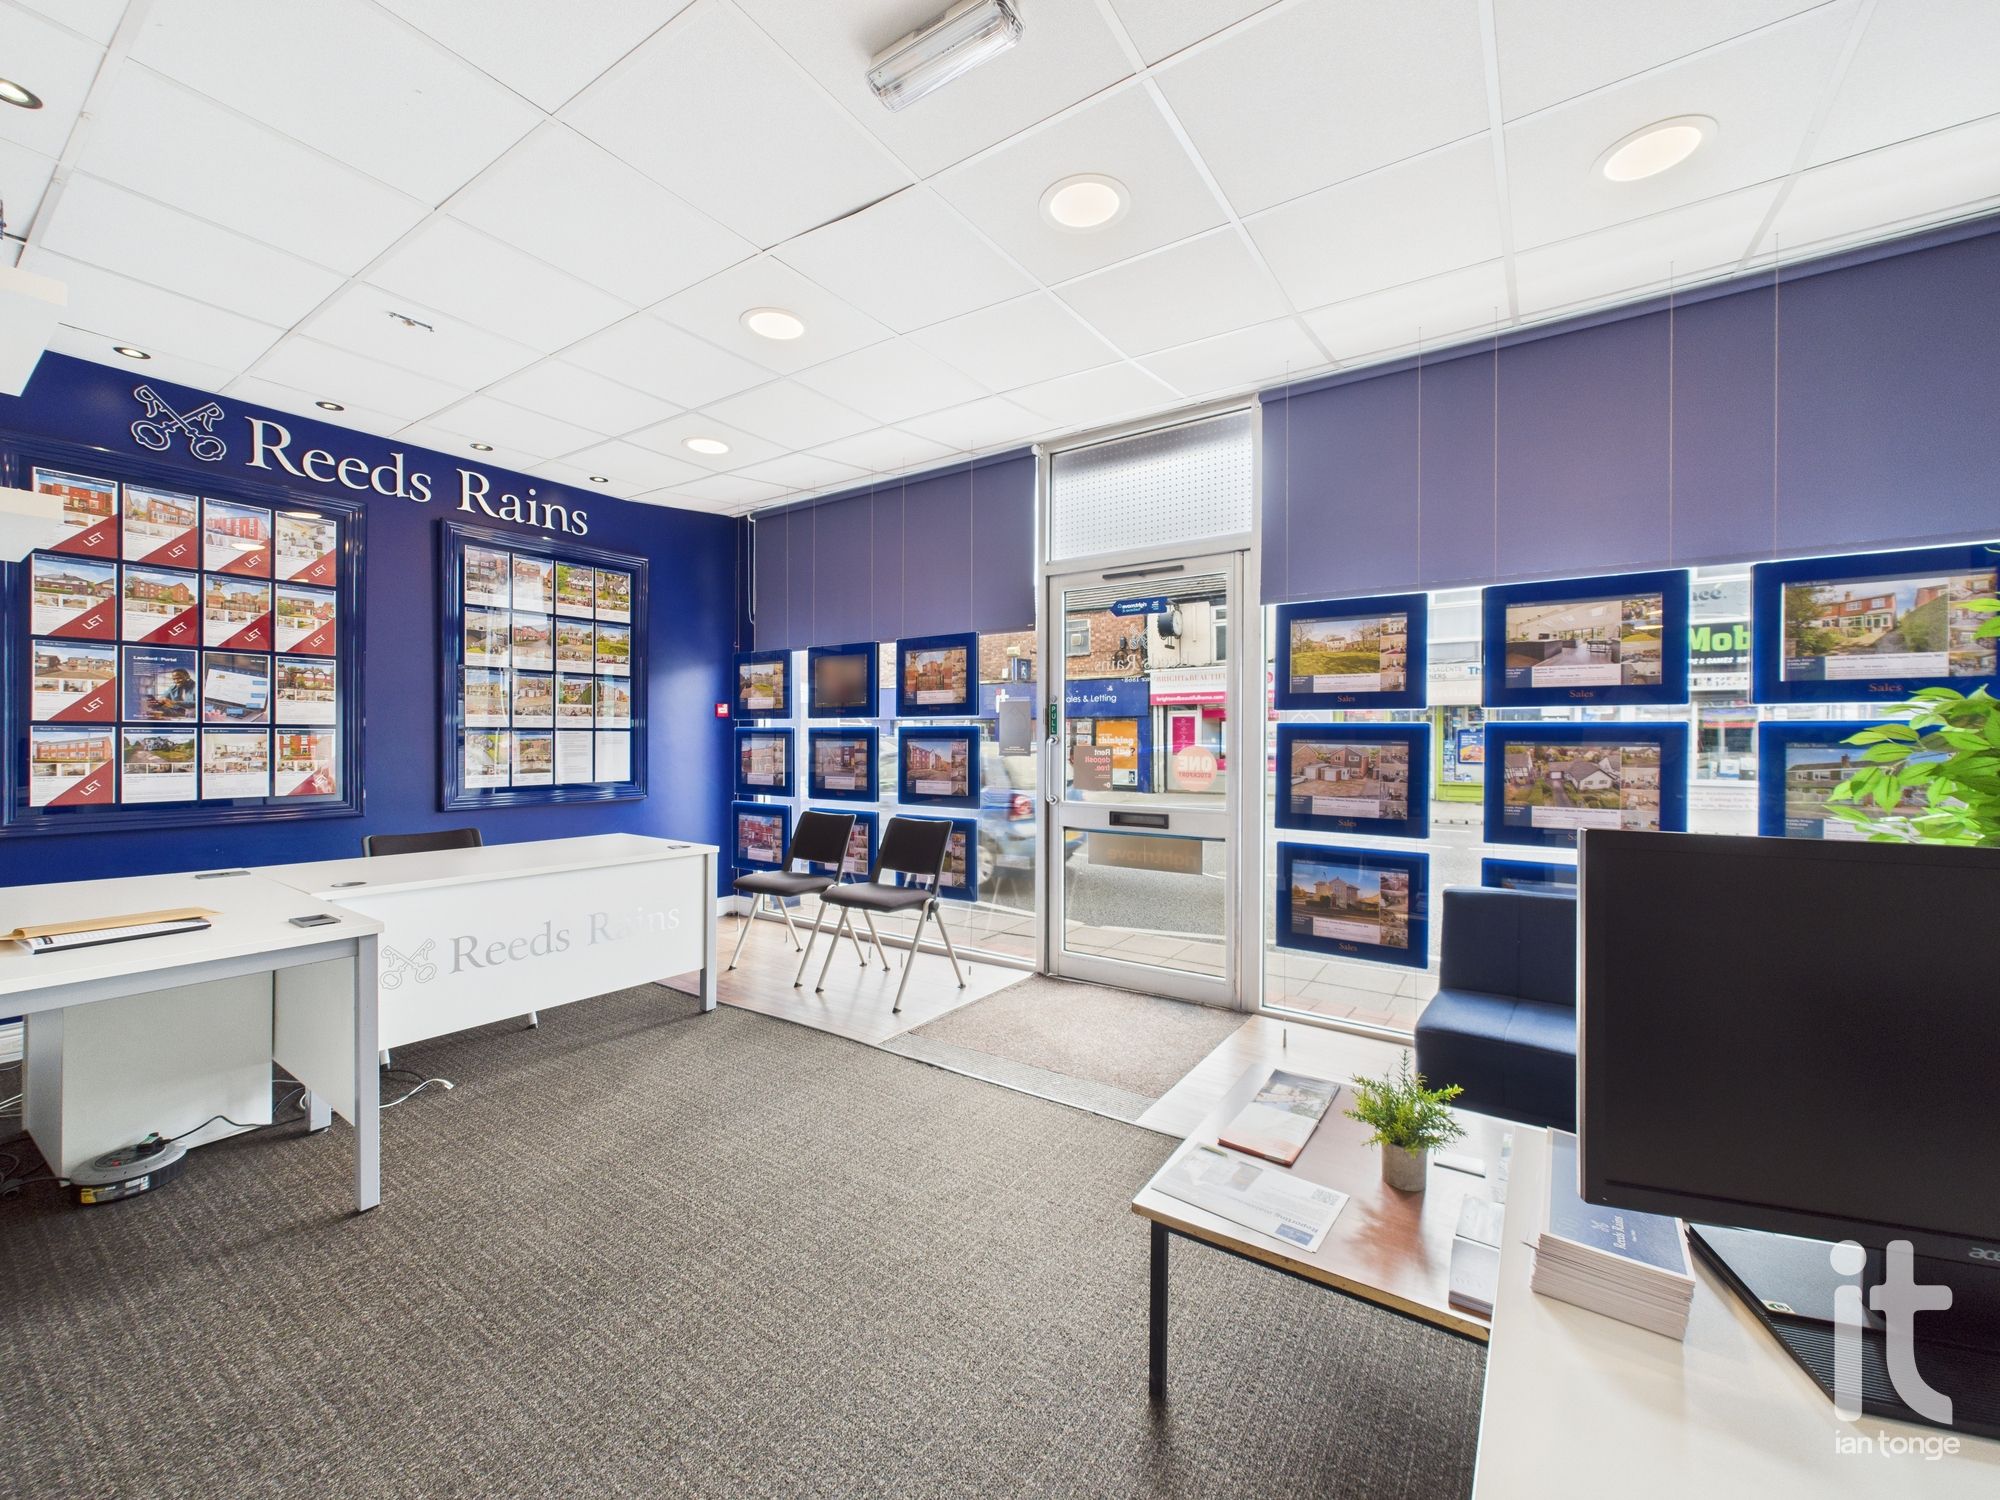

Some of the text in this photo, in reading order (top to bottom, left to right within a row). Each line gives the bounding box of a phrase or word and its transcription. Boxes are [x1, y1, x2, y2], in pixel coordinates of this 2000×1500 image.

[245, 416, 589, 536] Reeds Rains
[83, 532, 105, 547] LET
[168, 544, 188, 559] LET
[244, 555, 262, 569] LET
[311, 564, 327, 578] LET
[82, 614, 104, 631] LET
[168, 622, 188, 637] LET
[244, 627, 262, 642] LET
[310, 634, 326, 648] LET
[1569, 690, 1594, 698] Sales
[1868, 683, 1903, 692] Sales
[82, 697, 104, 714] LET
[1083, 695, 1089, 703] &
[1090, 694, 1117, 704] Letting
[1337, 695, 1356, 703] Sales
[80, 779, 102, 797] LET
[312, 774, 328, 788] LET
[1338, 818, 1357, 828] Sales
[449, 906, 681, 974] Reeds Rains
[1338, 943, 1359, 952] Sales
